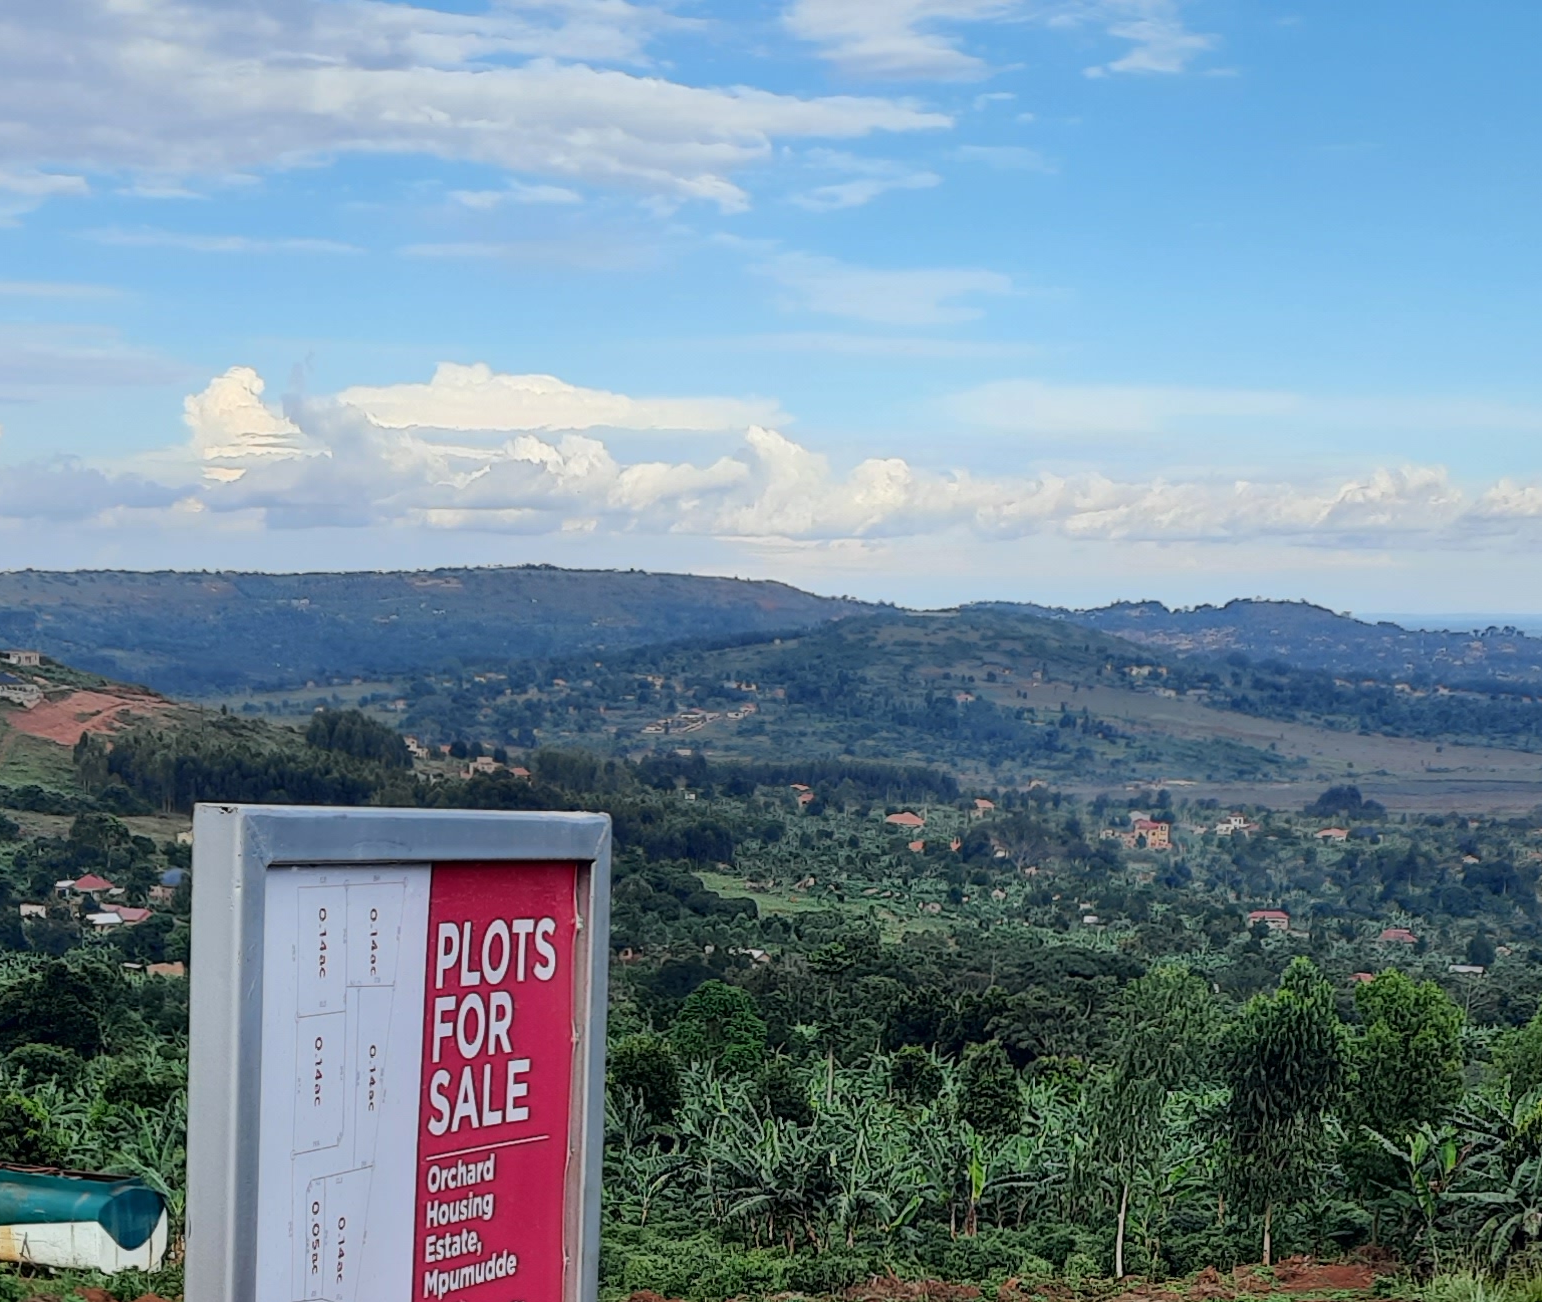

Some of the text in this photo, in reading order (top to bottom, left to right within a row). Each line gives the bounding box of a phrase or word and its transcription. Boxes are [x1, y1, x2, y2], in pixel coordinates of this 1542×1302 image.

[435, 917, 556, 989] PLOTS
[432, 991, 513, 1063] FOR
[427, 1058, 531, 1136] SALE
[427, 1153, 496, 1193] Orchard
[426, 1191, 494, 1228] Housing
[425, 1228, 482, 1263] Estate,
[423, 1249, 517, 1300] Mpumudde
